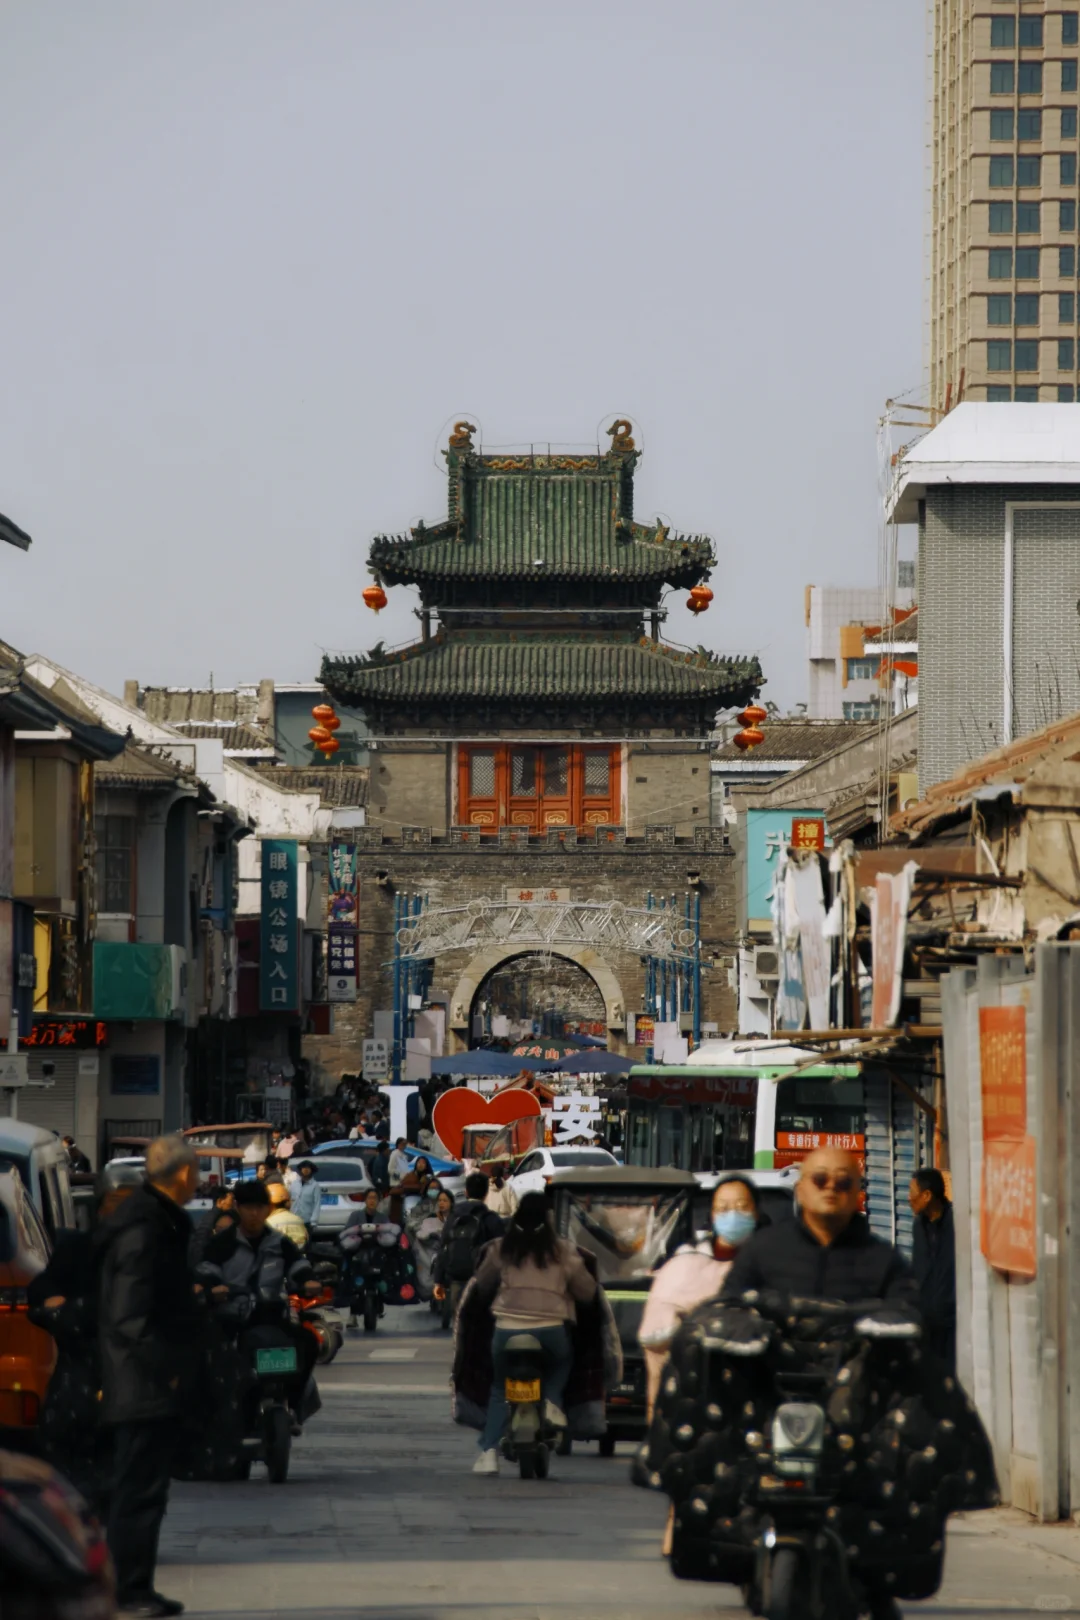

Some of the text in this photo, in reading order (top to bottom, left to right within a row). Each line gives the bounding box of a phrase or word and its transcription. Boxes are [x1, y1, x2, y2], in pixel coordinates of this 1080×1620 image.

[269, 852, 288, 1003] 眼镜公场入口
[551, 1090, 602, 1143] 安
